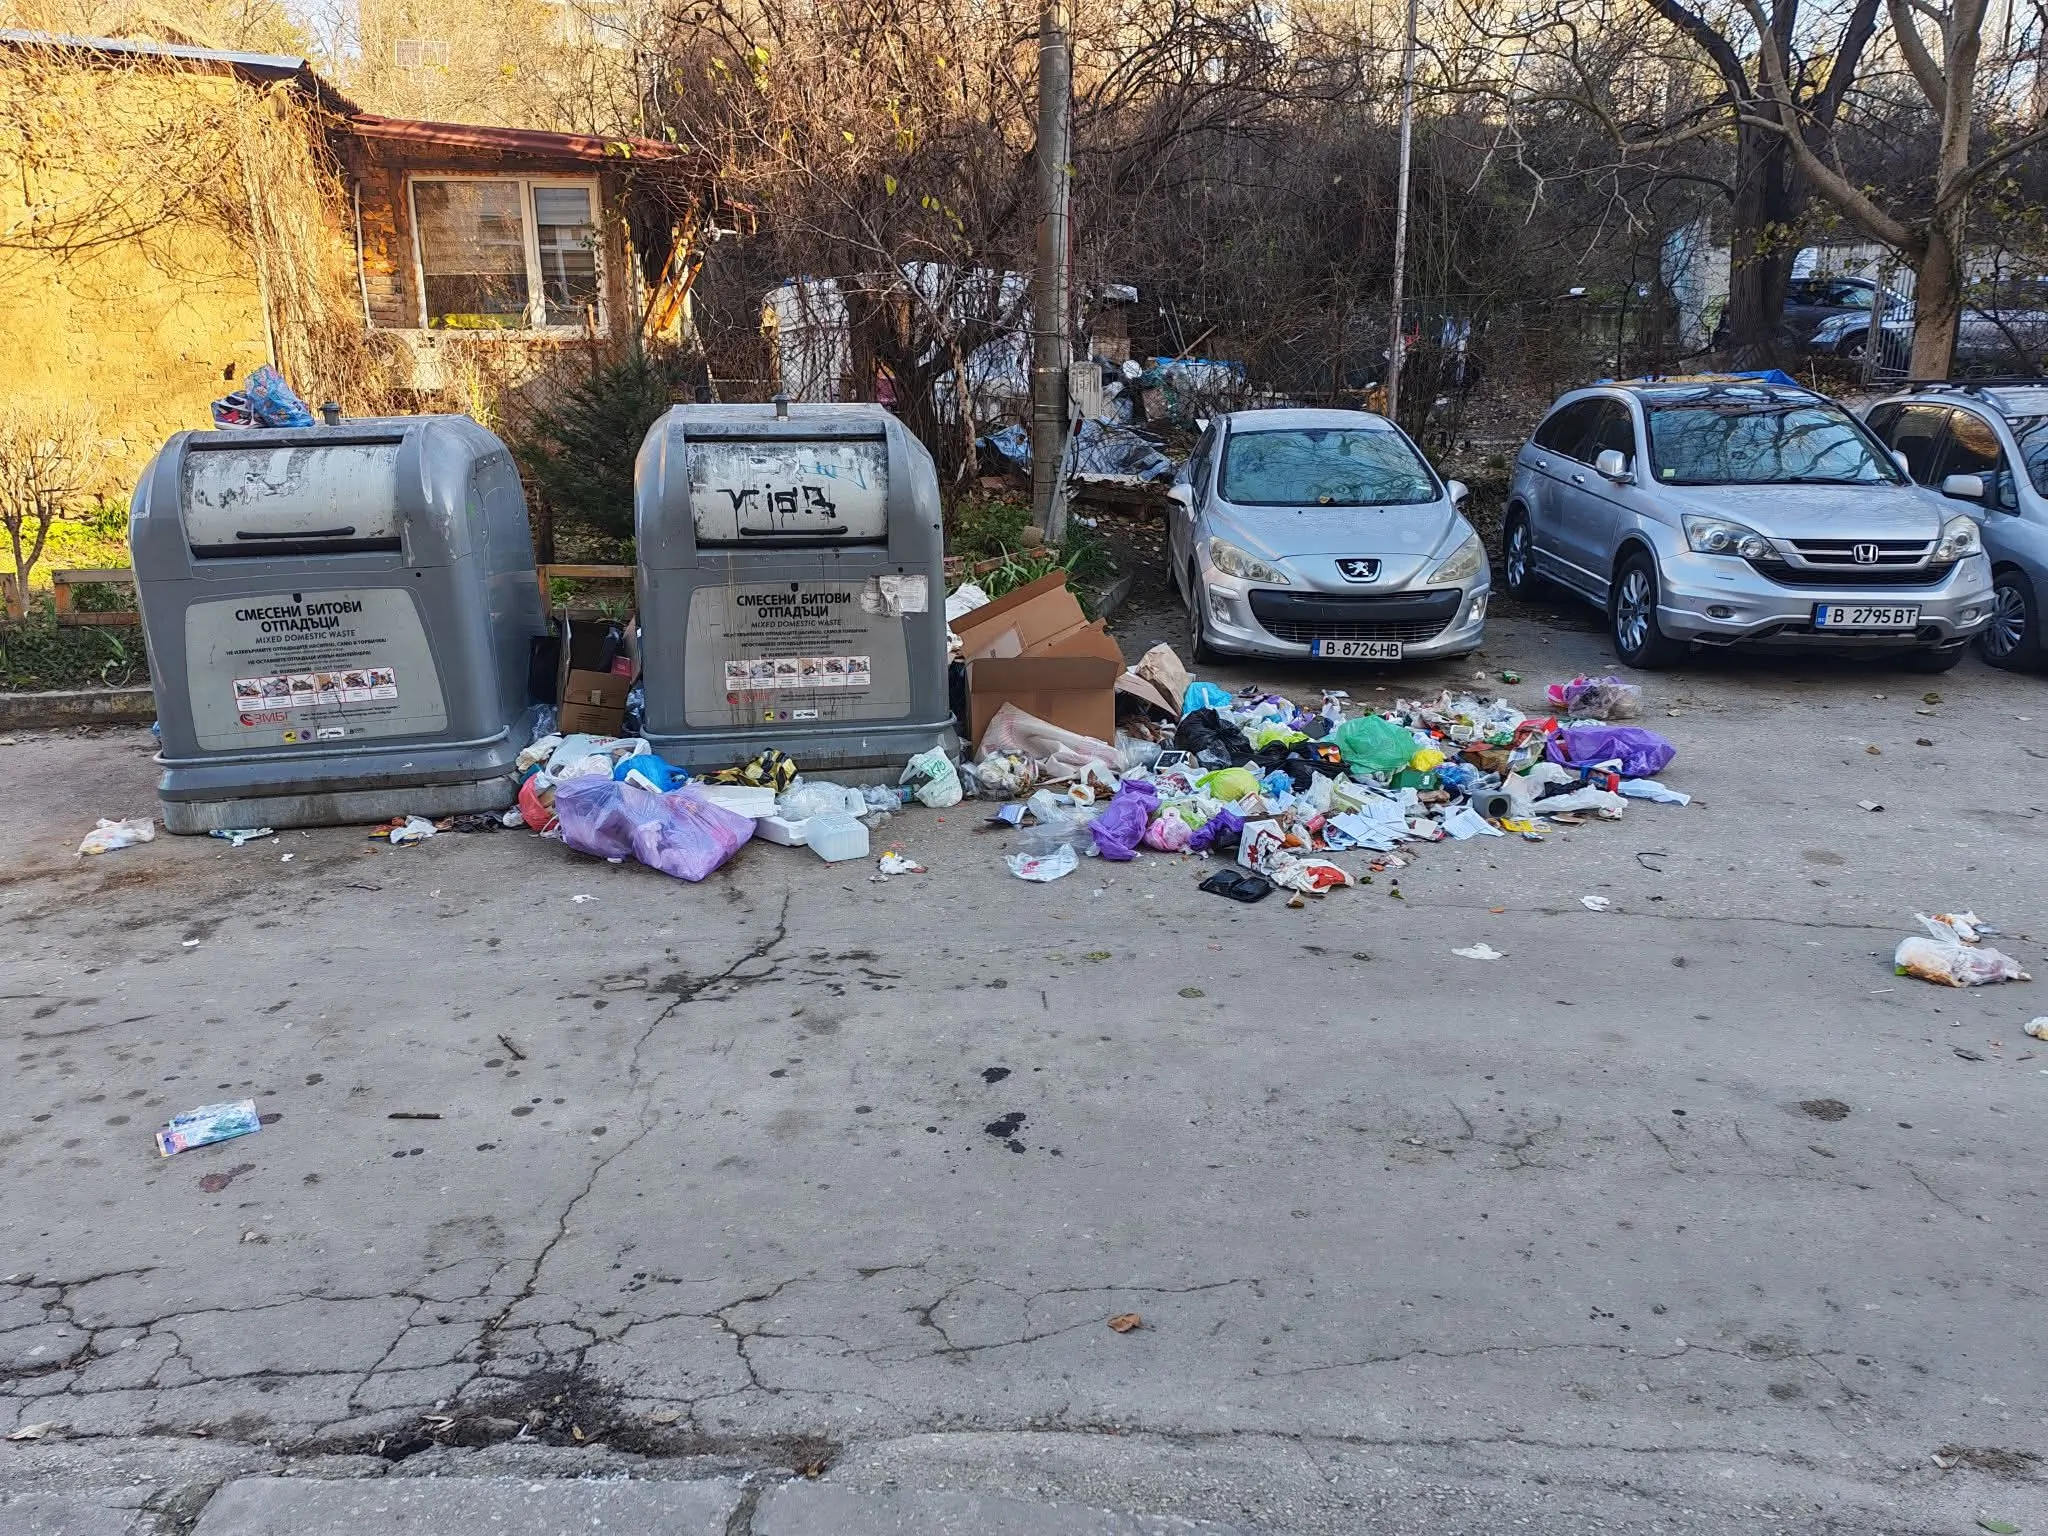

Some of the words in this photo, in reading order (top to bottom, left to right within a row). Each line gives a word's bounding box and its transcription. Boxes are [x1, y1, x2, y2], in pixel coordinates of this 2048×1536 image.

[737, 592, 797, 606] СМЕСЕНИ
[801, 592, 851, 605] БИТОВИ
[235, 605, 301, 622] СМЕСЕНИ
[307, 600, 362, 616] БИТОВИ
[758, 605, 829, 619] ОТПАДЪЦИ
[1833, 609, 1844, 623] B
[1852, 608, 1891, 624] 2795
[1893, 609, 1916, 624] BT
[261, 616, 340, 633] ОТПАДЪЦИ
[777, 620, 817, 628] DOMESTIC
[255, 636, 282, 644] MIXED
[284, 632, 327, 642] DOMESTIC
[329, 629, 356, 638] WASTE
[1326, 641, 1335, 655] B
[1342, 642, 1377, 656] 8726
[1379, 643, 1399, 657] HB
